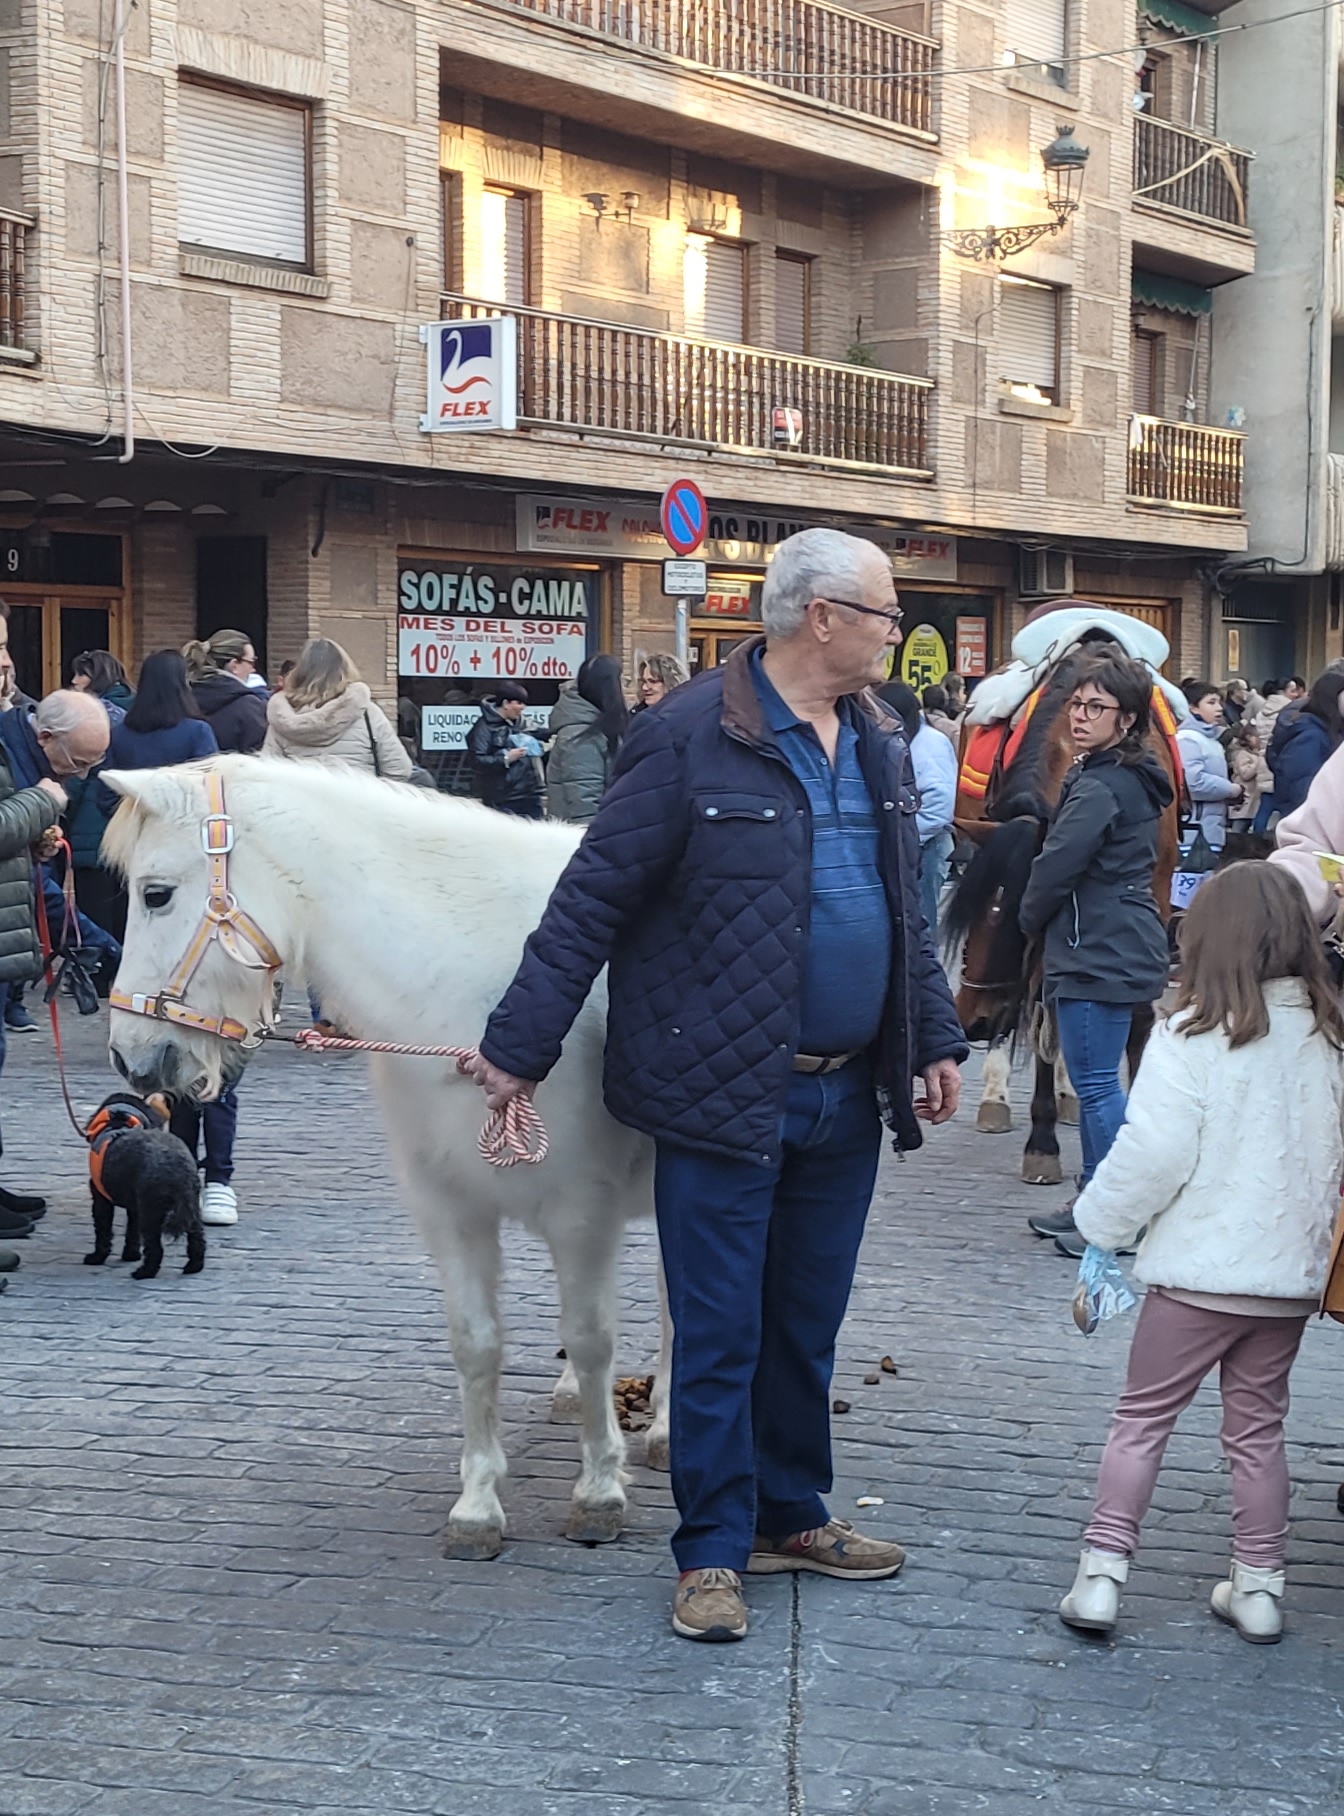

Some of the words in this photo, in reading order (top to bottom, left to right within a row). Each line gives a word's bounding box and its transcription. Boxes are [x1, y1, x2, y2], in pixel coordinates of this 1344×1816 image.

[440, 400, 492, 417] FLEX
[552, 507, 611, 533] FLEX
[907, 539, 950, 559] FLEX
[7, 549, 19, 571] 9
[511, 577, 589, 617] CAMA
[705, 595, 751, 614] FLEX
[400, 616, 455, 631] MES
[465, 619, 512, 633] DEL
[522, 622, 584, 636] SOFA
[411, 643, 461, 675] 10%
[491, 646, 537, 676] 10%
[542, 656, 572, 677] dto.
[959, 646, 972, 673] 12
[428, 714, 477, 728] LIQUIDAC
[432, 731, 466, 743] RENO
